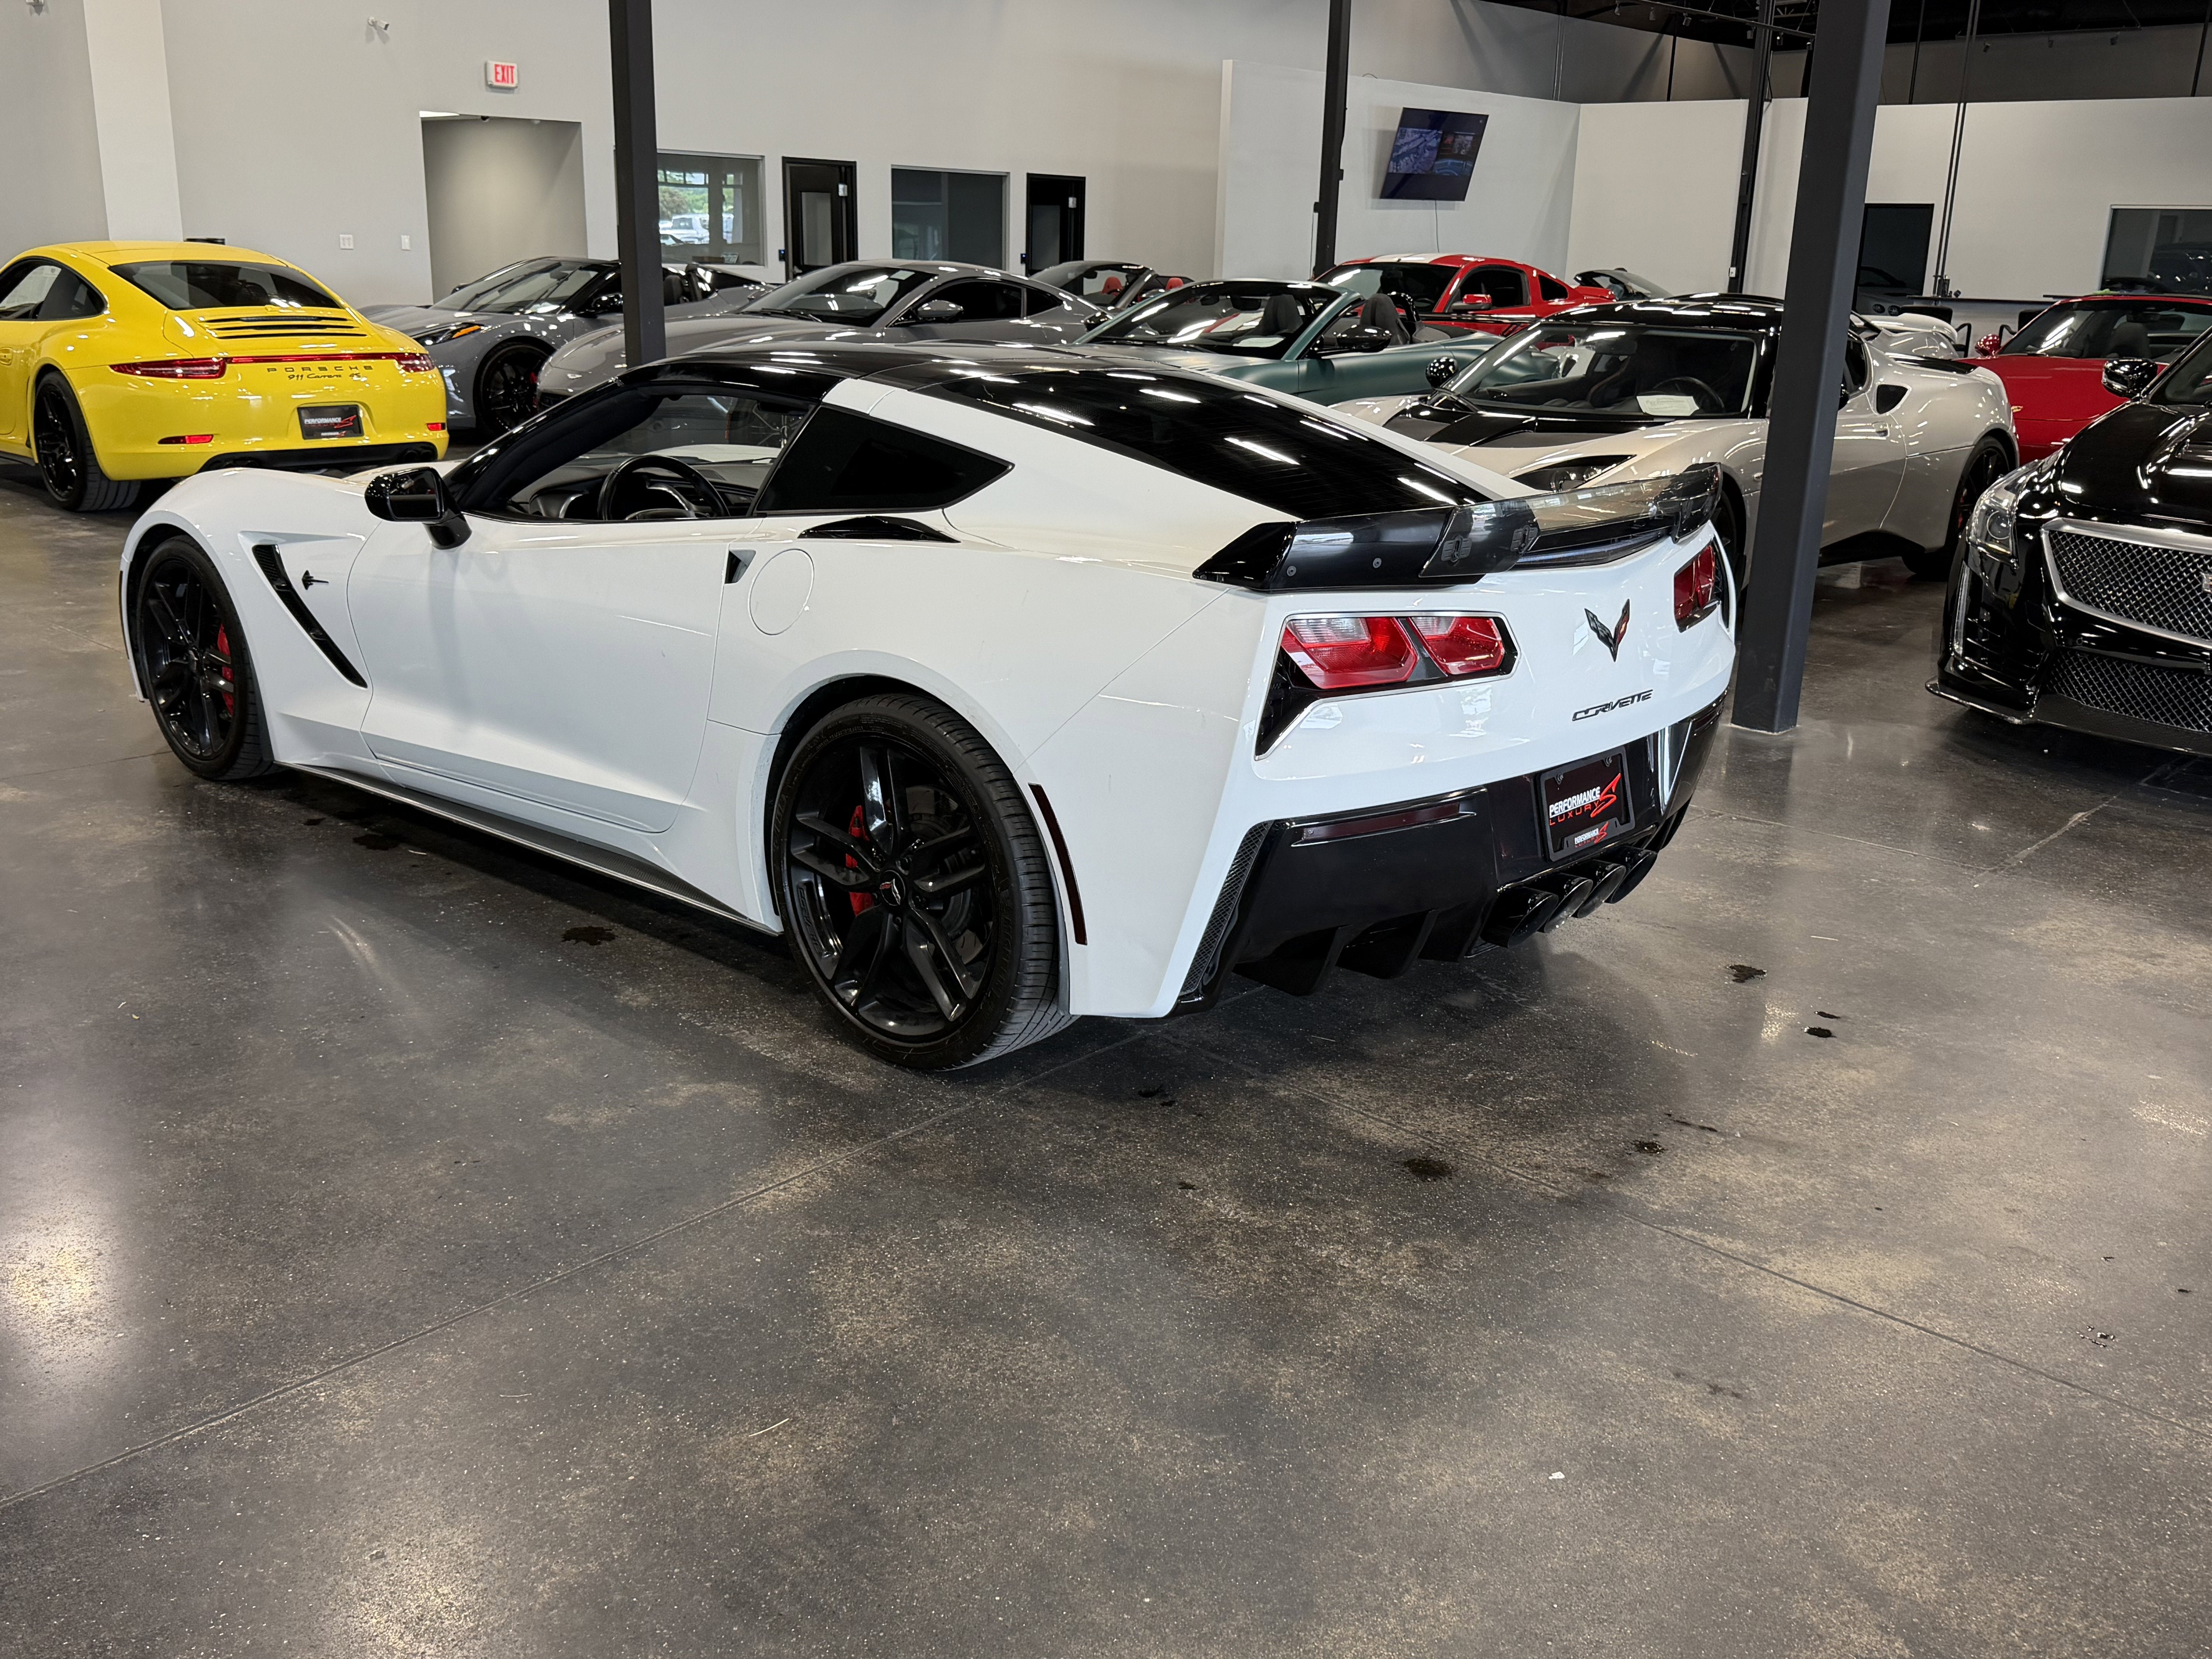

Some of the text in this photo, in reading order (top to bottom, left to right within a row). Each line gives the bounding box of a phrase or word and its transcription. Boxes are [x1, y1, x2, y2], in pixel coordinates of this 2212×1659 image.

[495, 64, 514, 84] EXIT
[1572, 689, 1653, 721] CORVETTE
[1549, 787, 1601, 817] PERFORMANCE
[1549, 800, 1599, 826] LUXURY
